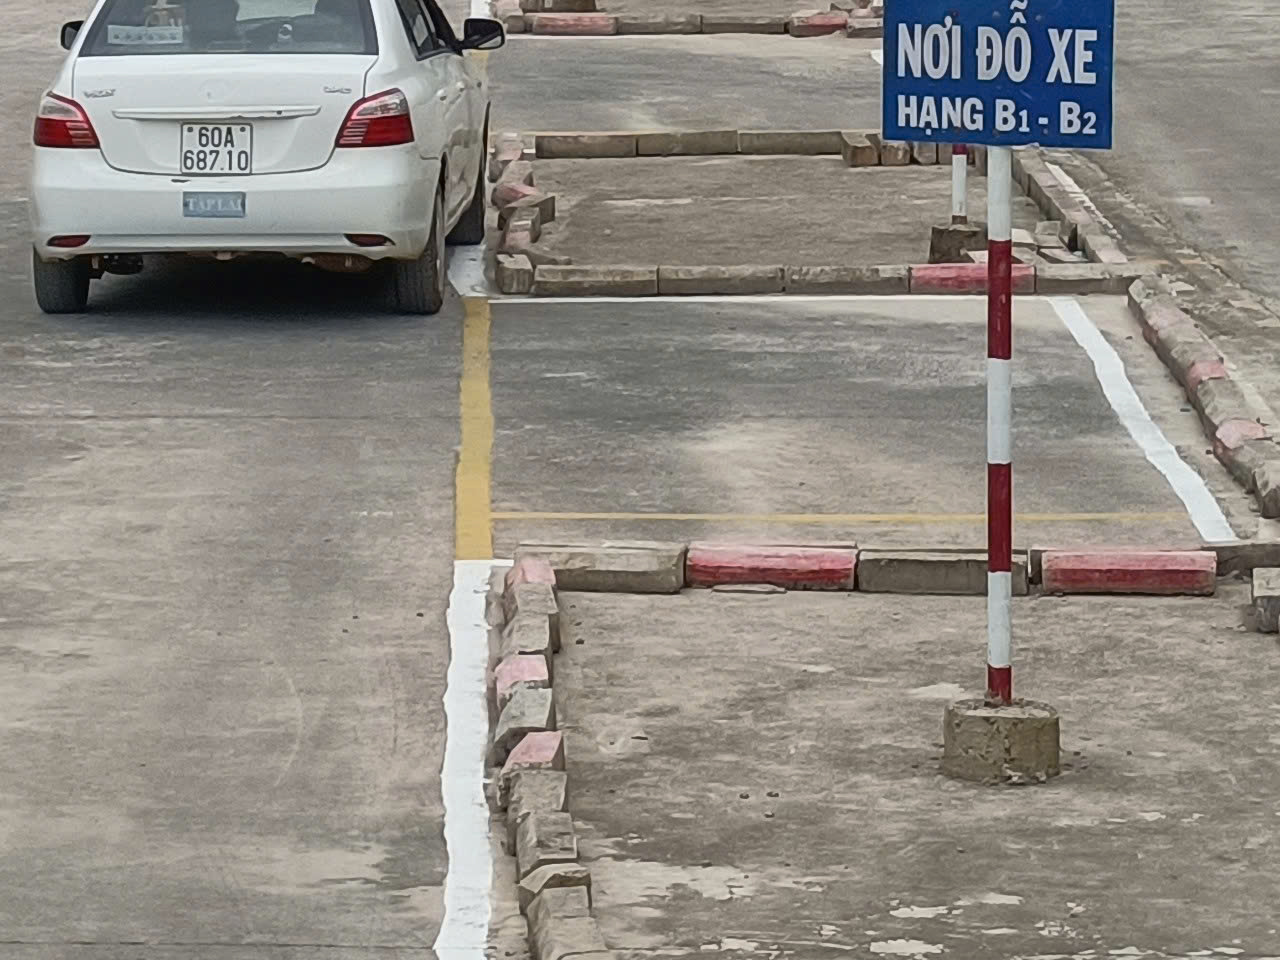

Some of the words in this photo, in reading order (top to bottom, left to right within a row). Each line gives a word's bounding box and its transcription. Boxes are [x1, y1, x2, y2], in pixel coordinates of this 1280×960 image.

[897, 15, 961, 79] NƠI
[976, 0, 1032, 83] ĐỖ
[1045, 28, 1098, 85] XE
[897, 94, 984, 136] HẠNG
[994, 98, 1030, 133] B1
[1059, 101, 1097, 134] B2
[198, 126, 235, 148] 60A
[183, 149, 249, 171] 687.10
